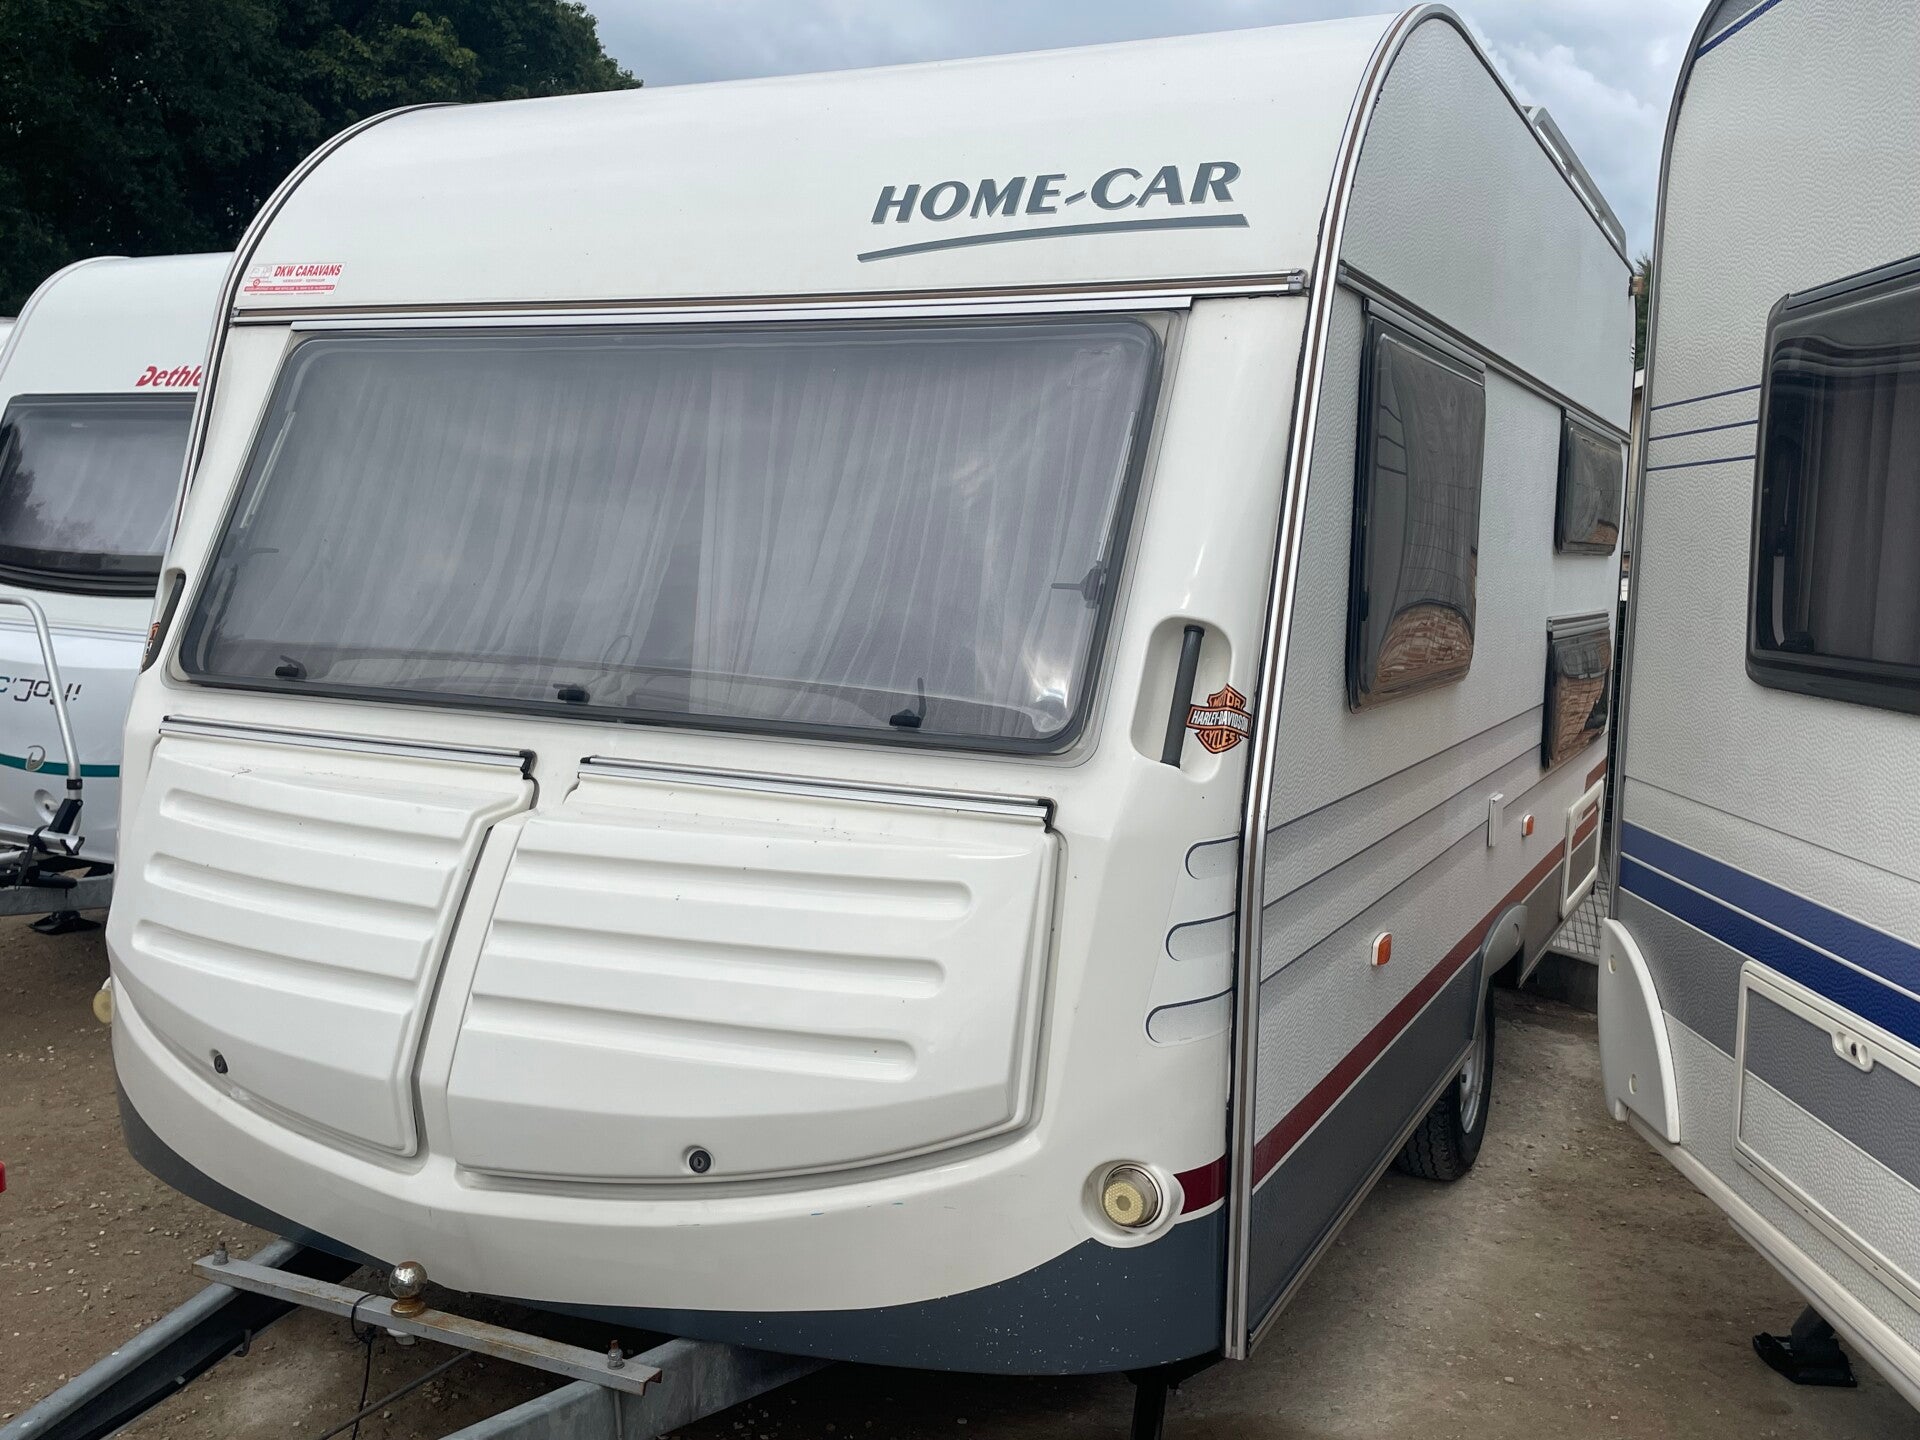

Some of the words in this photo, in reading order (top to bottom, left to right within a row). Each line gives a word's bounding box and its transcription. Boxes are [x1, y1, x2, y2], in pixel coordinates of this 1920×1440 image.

[870, 160, 1242, 225] HOME-CAR
[273, 266, 296, 277] DKW
[295, 264, 342, 276] CARAVANS
[1212, 689, 1241, 709] MOTOR
[1203, 730, 1236, 749] CYCLES
